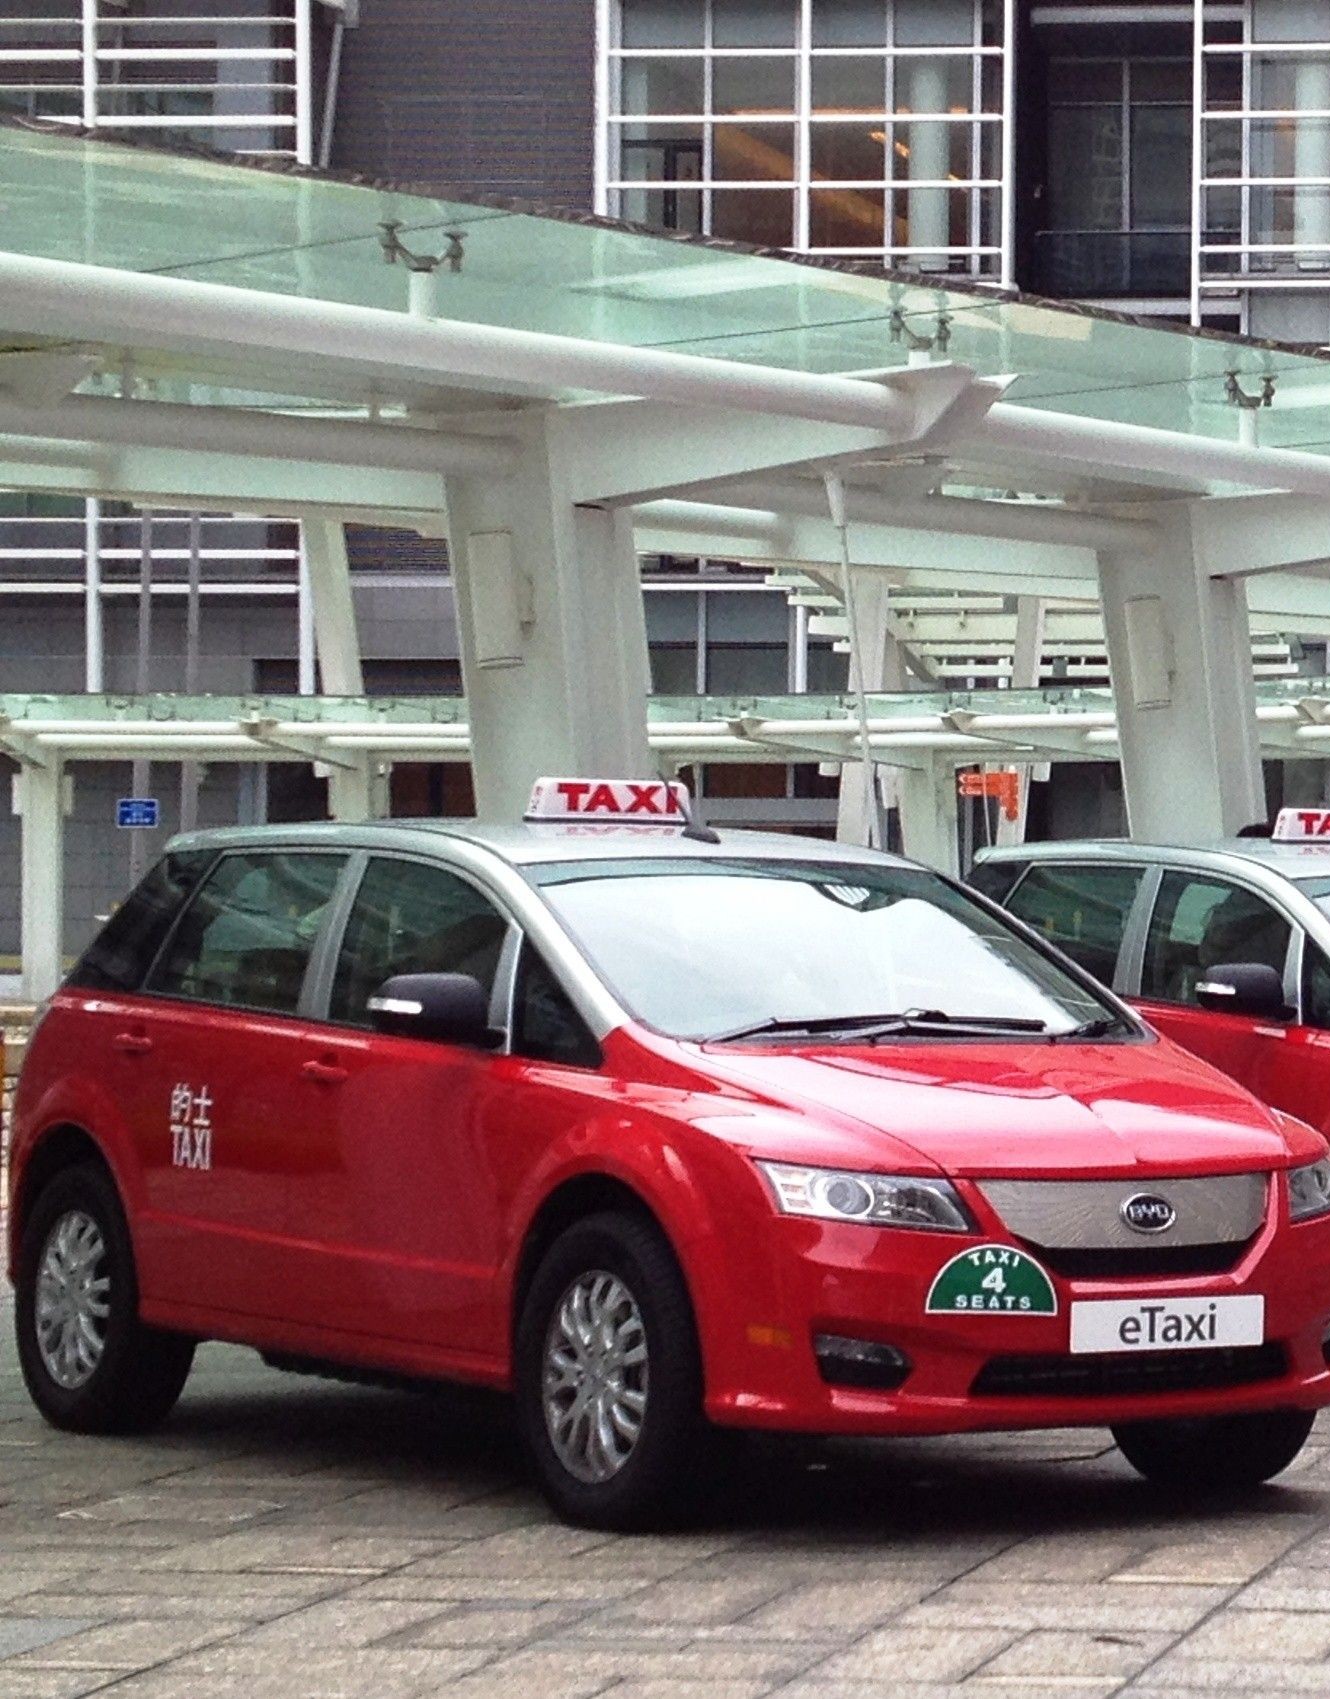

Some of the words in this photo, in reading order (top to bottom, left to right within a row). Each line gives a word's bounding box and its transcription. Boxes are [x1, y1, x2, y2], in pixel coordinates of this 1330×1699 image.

[557, 782, 679, 814] TAXI
[170, 1083, 213, 1126] 的士
[170, 1125, 211, 1170] TAXI
[1129, 1204, 1170, 1219] BYD
[968, 1249, 1021, 1268] TAXI
[981, 1267, 1007, 1293] 4
[955, 1295, 1032, 1310] SEATS
[1119, 1303, 1217, 1345] eTaxi
